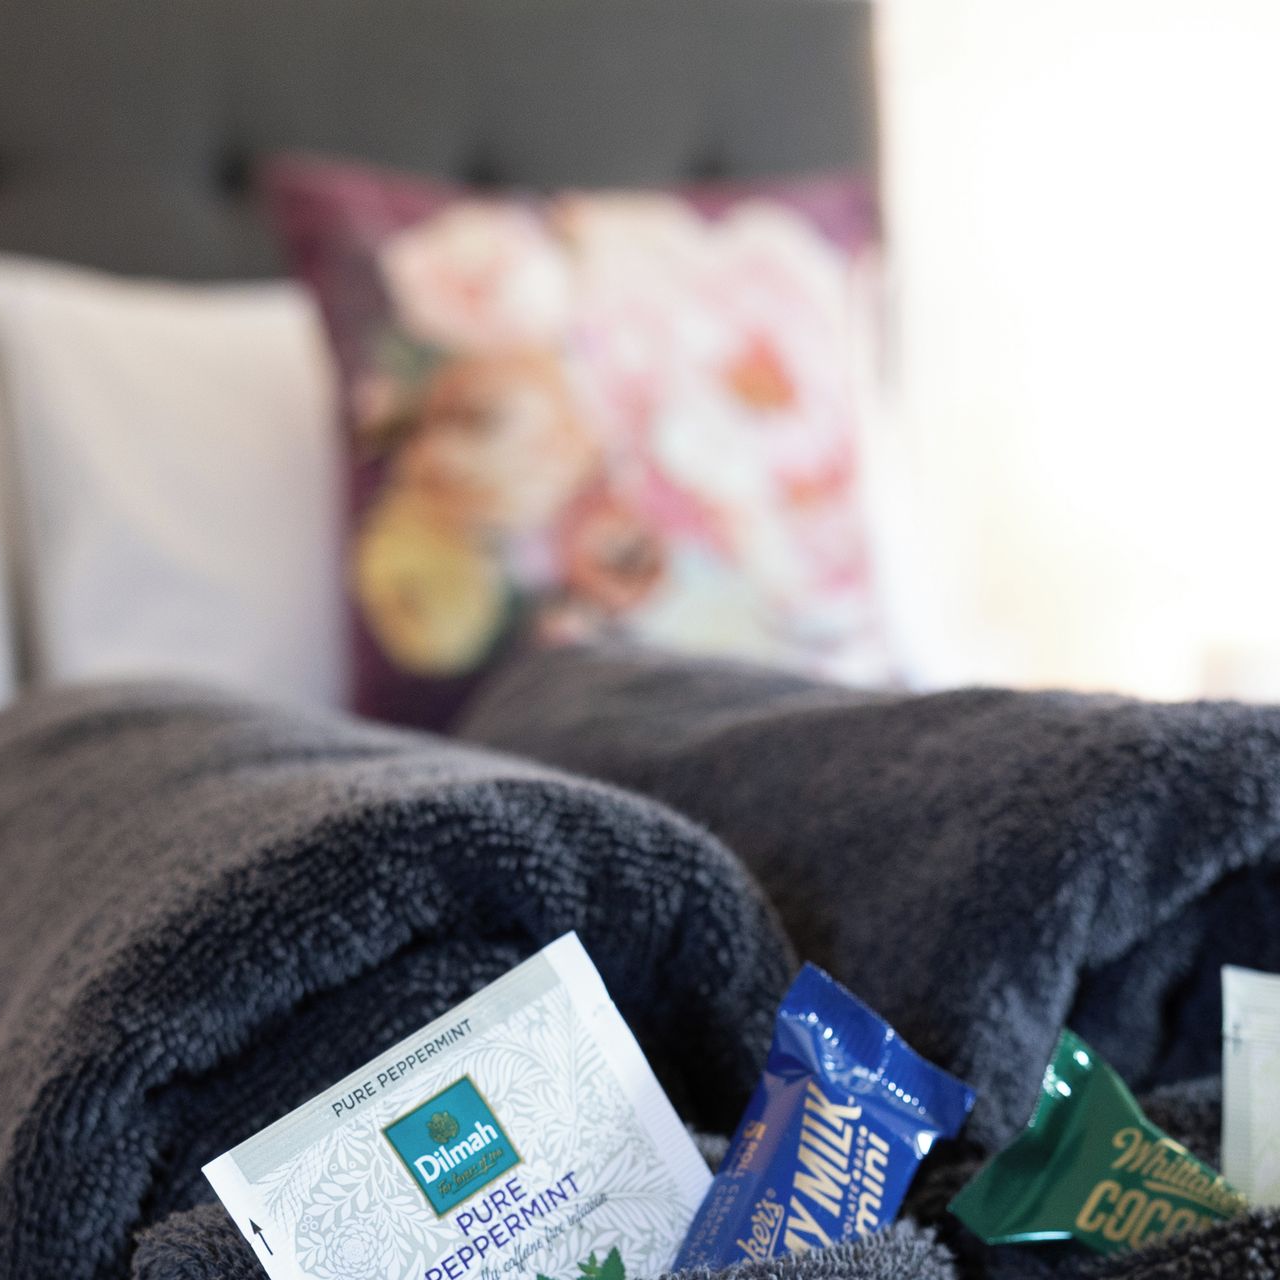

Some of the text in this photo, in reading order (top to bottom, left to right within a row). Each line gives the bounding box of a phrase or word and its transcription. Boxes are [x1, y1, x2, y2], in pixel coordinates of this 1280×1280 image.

[331, 1018, 473, 1118] PURE PEPPERMINT
[413, 1121, 498, 1184] Dilmah
[793, 1081, 862, 1218] MILK
[854, 1132, 890, 1235] mini
[456, 1177, 527, 1236] PURE
[1075, 1179, 1213, 1249] COCO
[503, 1238, 542, 1272] caffeine
[544, 1222, 565, 1244] free
